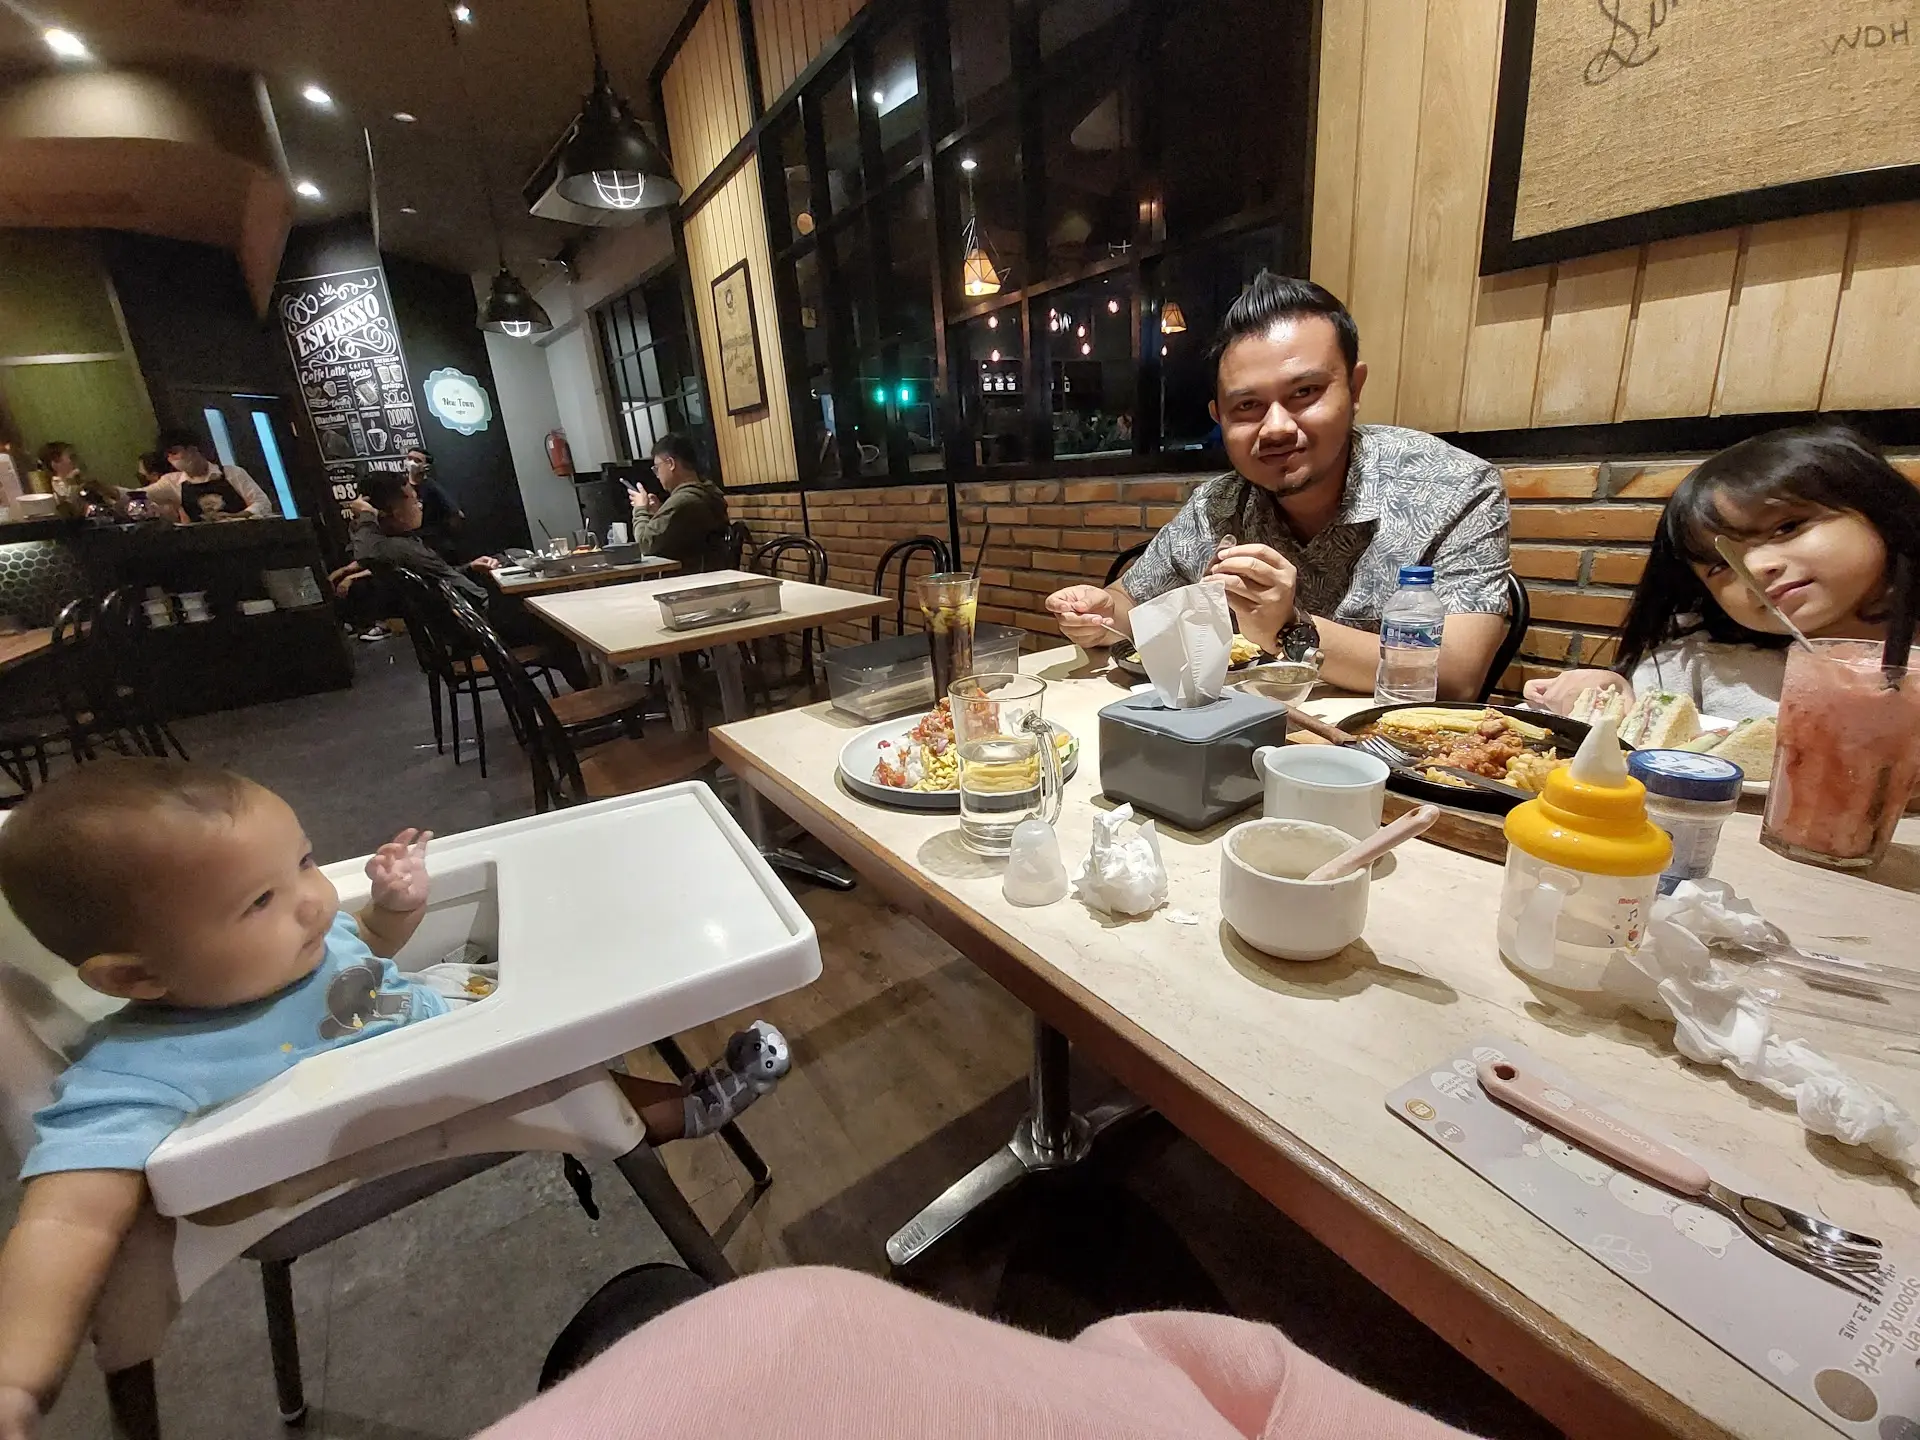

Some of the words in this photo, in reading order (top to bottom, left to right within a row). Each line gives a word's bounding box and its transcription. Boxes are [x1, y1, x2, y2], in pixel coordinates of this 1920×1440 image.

[296, 293, 380, 358] ESPRESSO
[383, 391, 409, 405] SOLO
[1853, 1332, 1897, 1375] Fork
